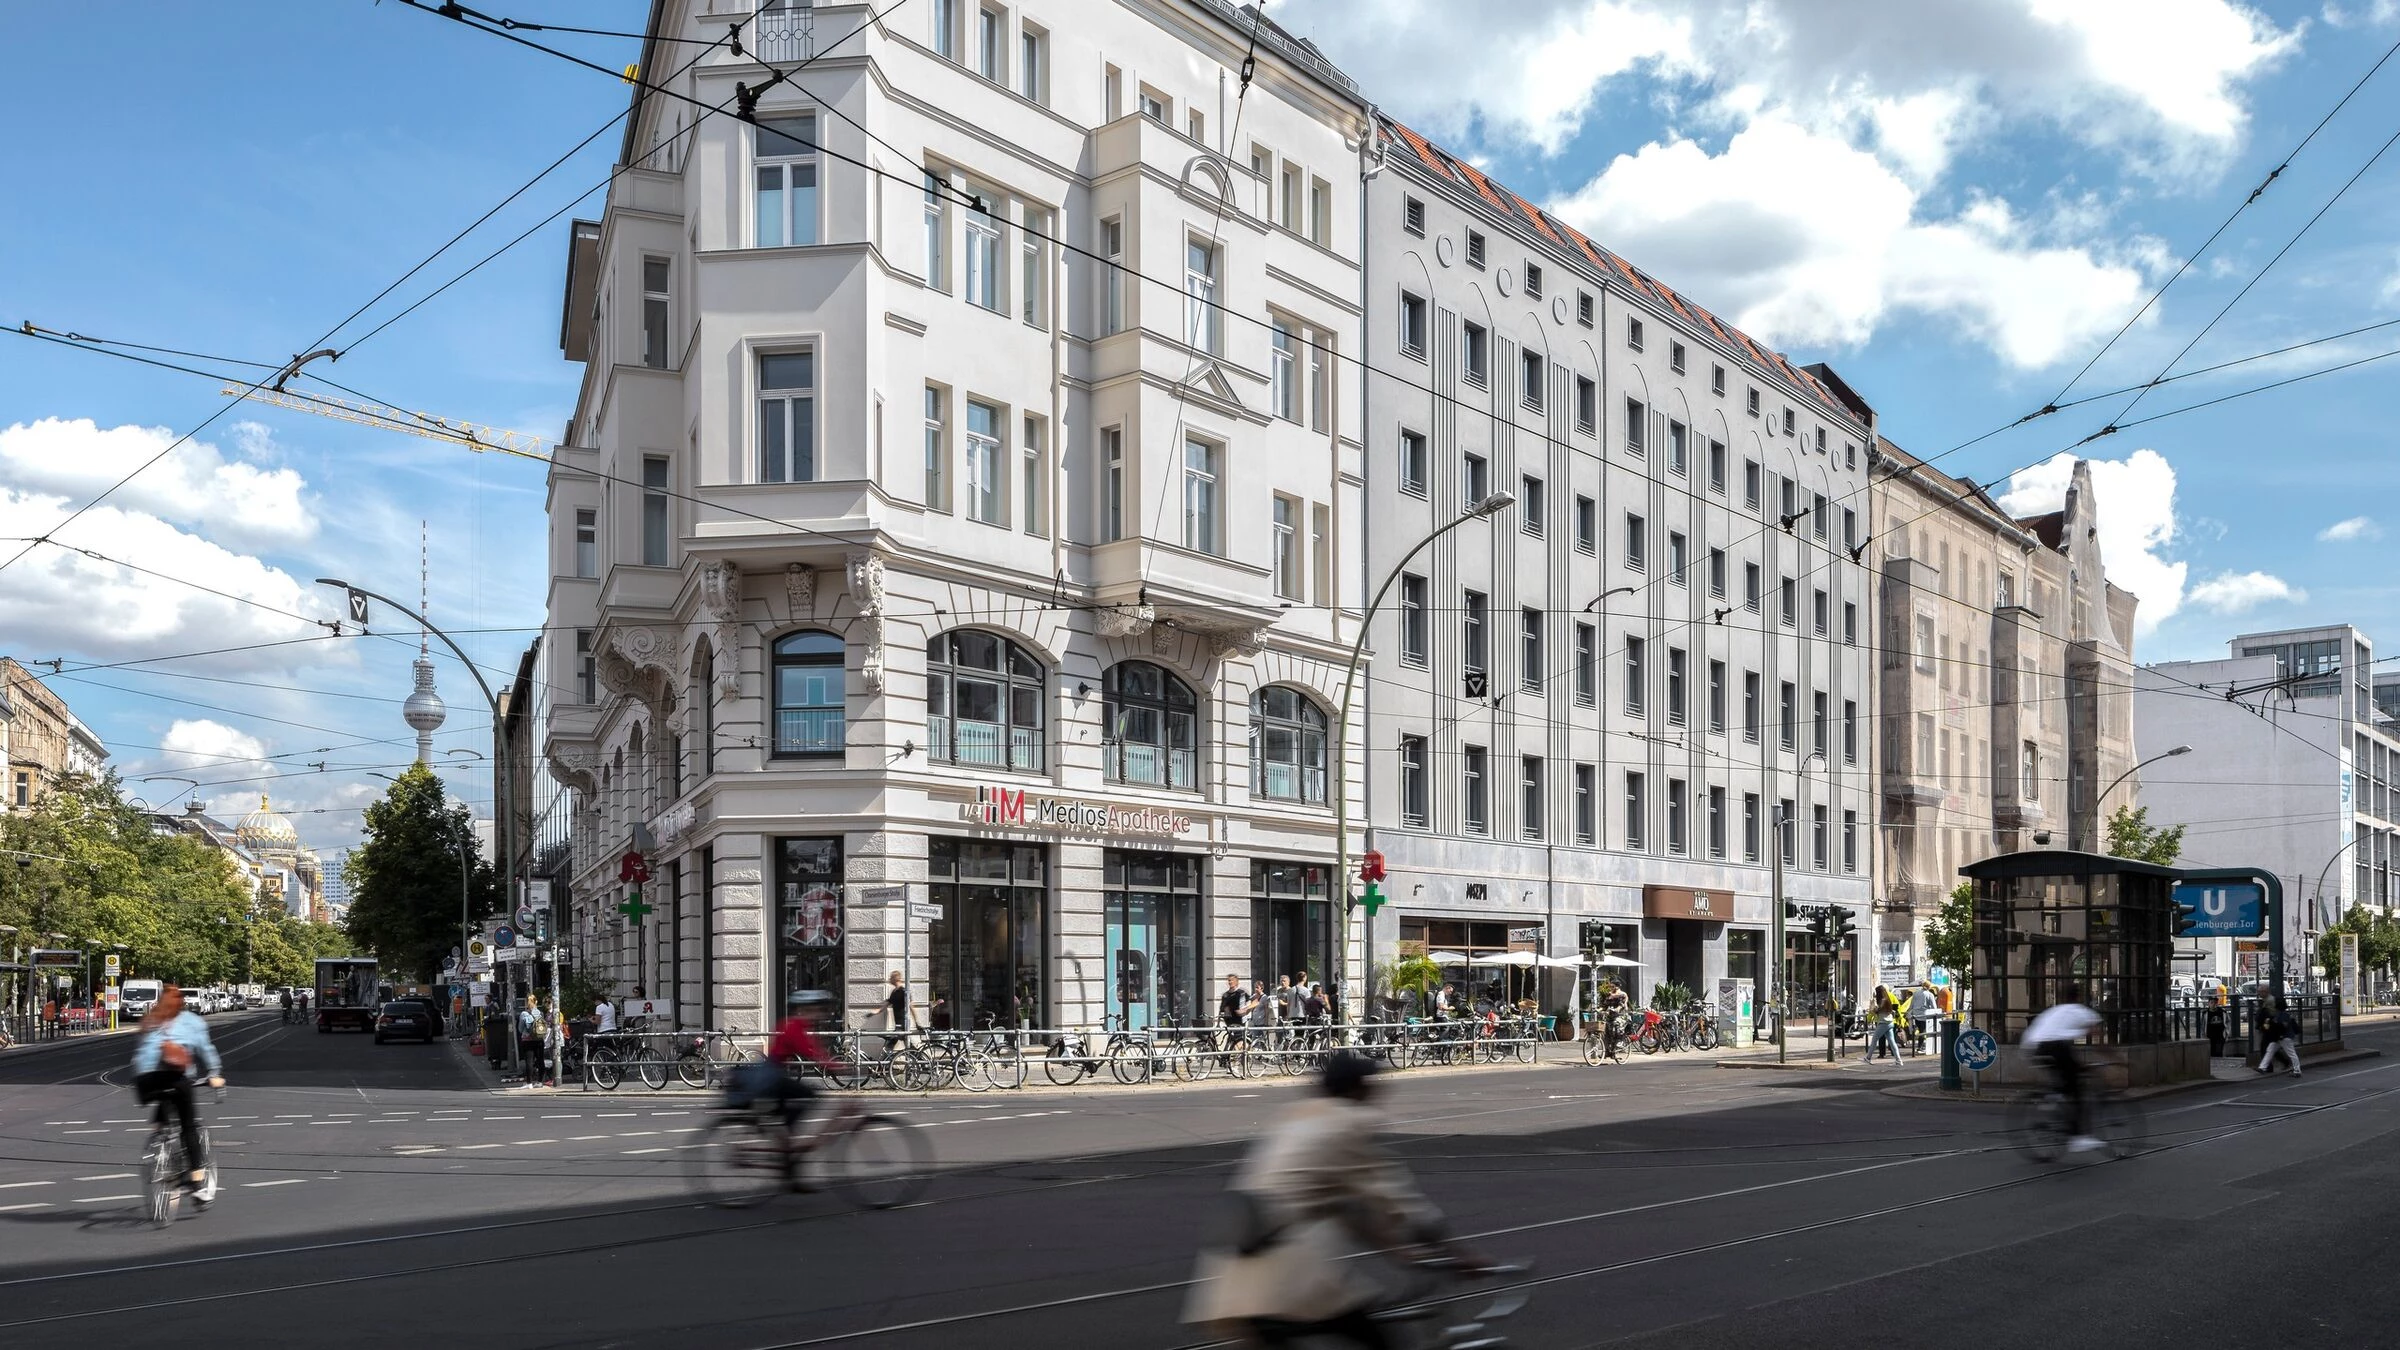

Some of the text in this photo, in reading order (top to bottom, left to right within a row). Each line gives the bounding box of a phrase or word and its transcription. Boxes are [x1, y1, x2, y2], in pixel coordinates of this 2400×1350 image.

[1039, 798, 1191, 833] MediosApotheke
[2203, 889, 2226, 916] U
[2240, 920, 2255, 929] Tor
